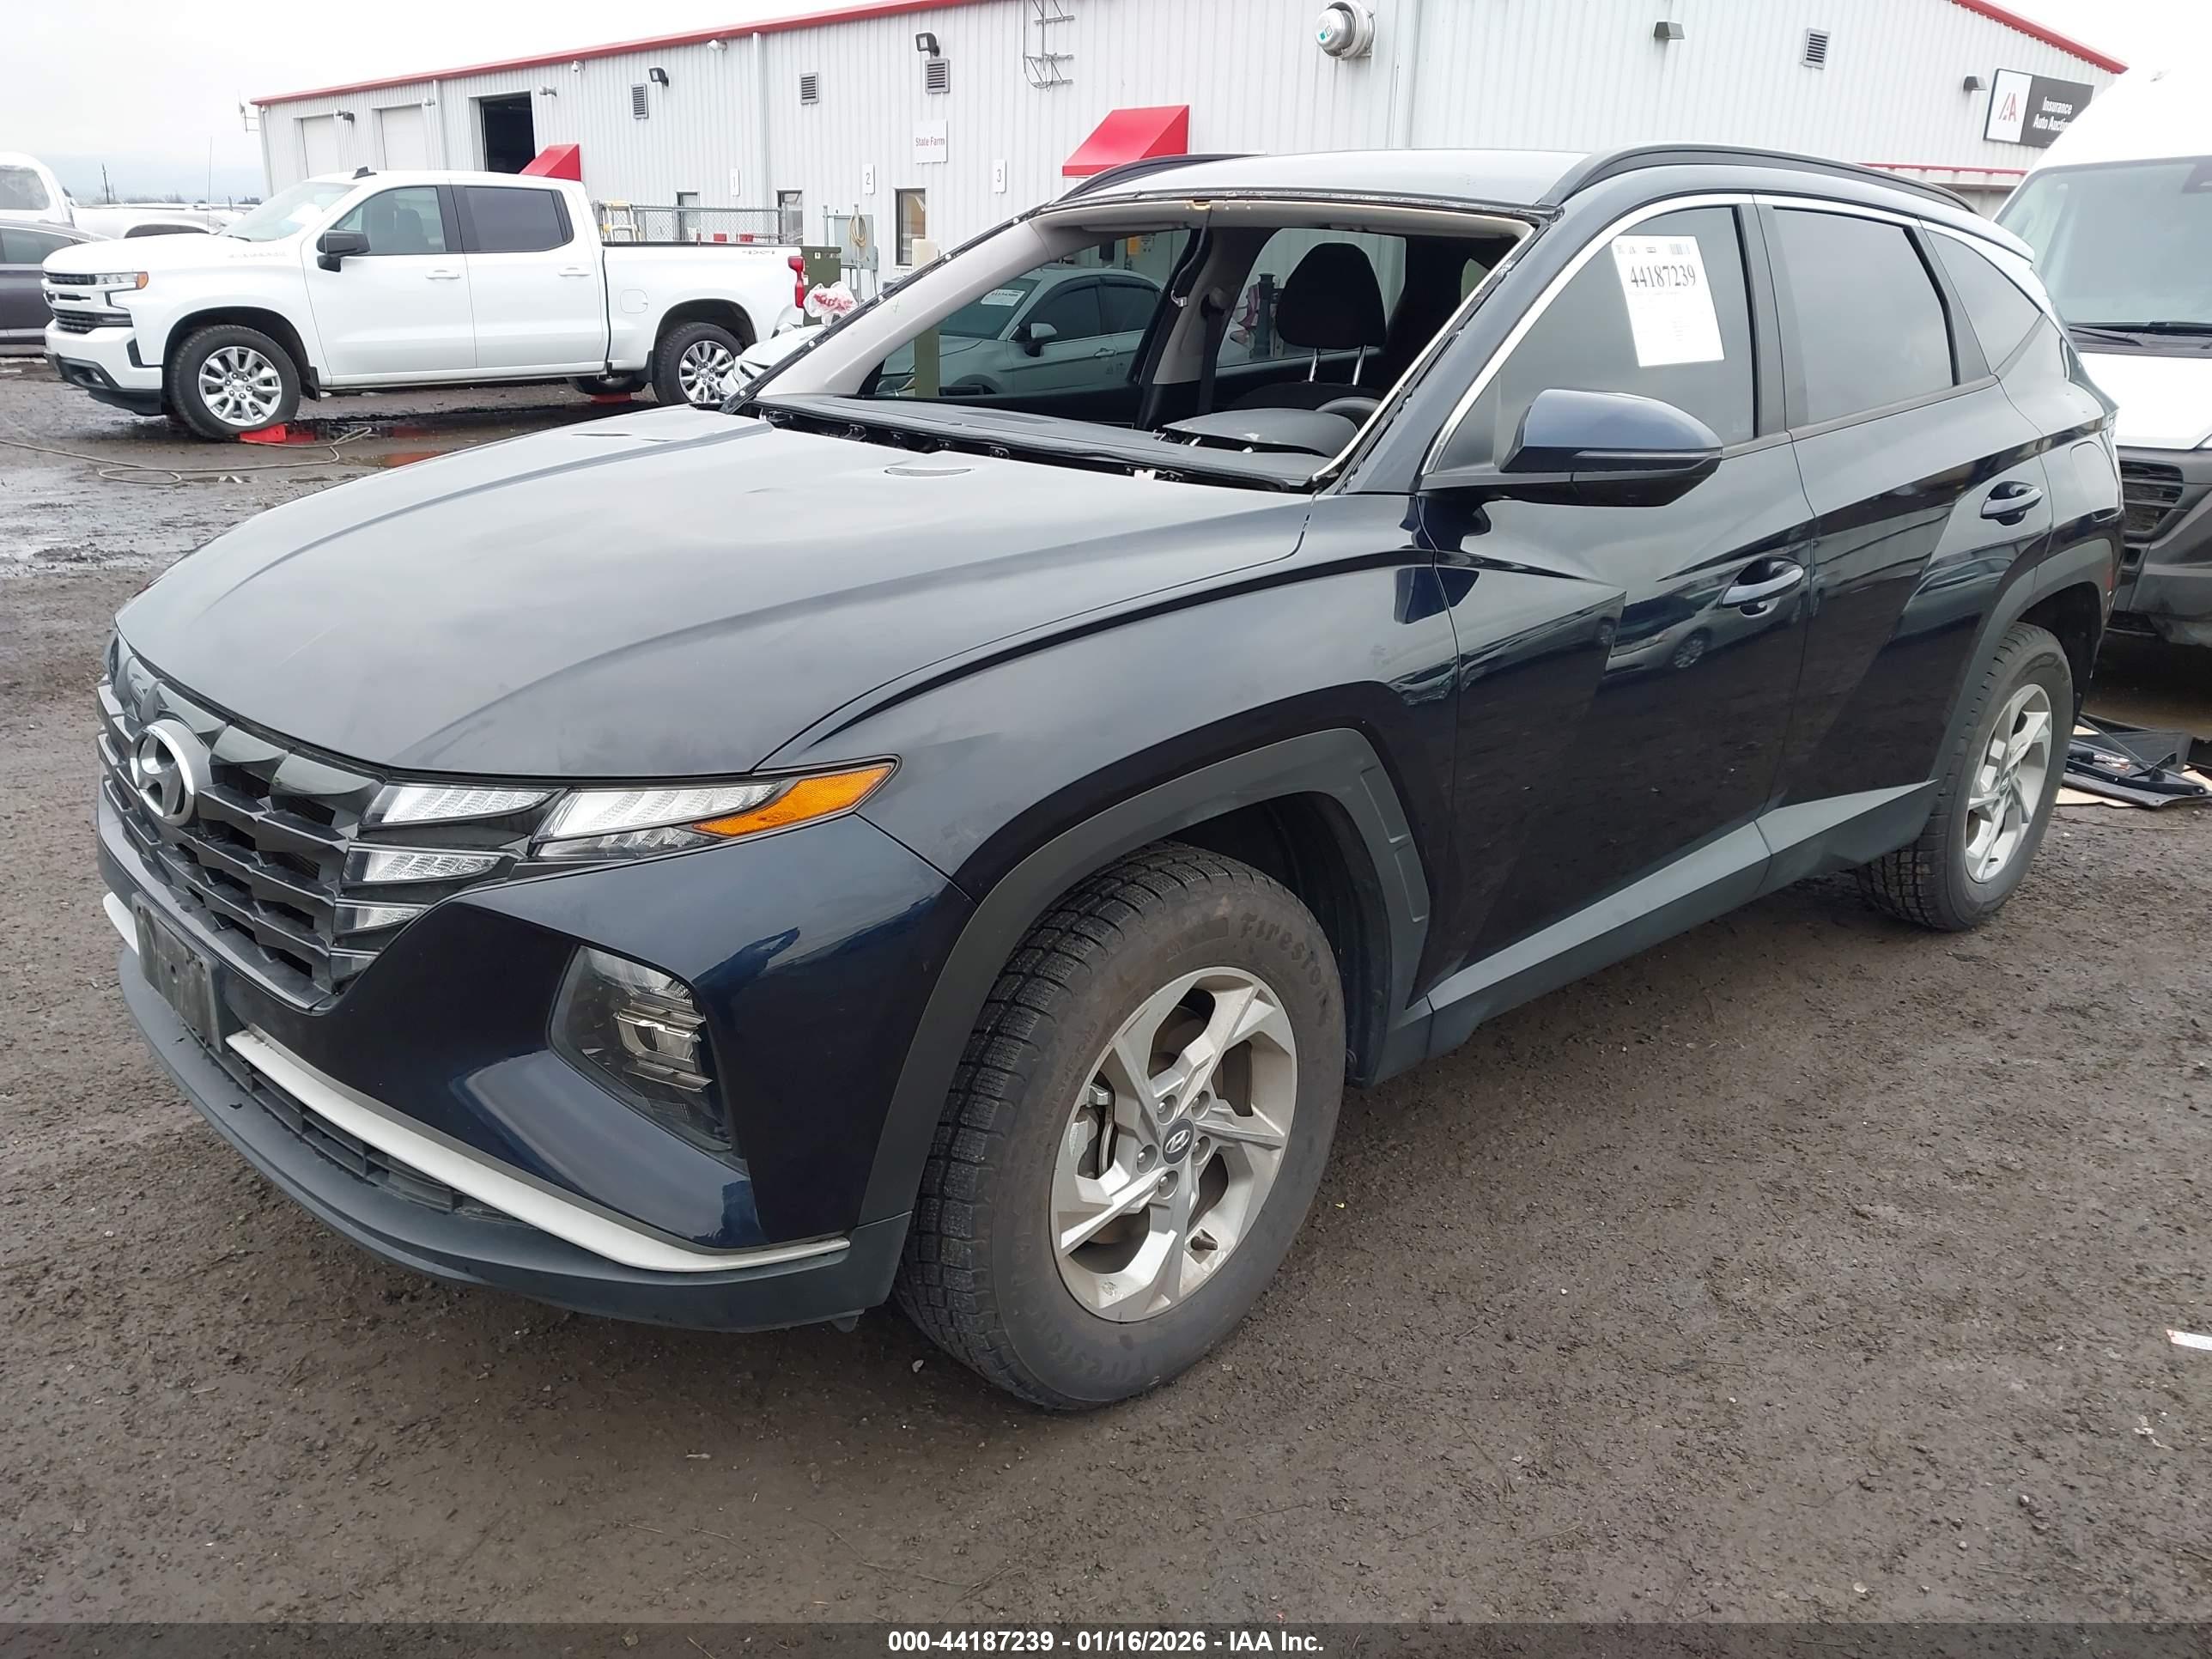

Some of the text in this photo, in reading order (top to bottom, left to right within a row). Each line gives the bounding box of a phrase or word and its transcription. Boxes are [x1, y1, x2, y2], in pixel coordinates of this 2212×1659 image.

[2043, 95, 2073, 115] Insurance
[2033, 113, 2049, 129] Auto
[915, 136, 945, 147] State Farm
[866, 173, 871, 185] 2
[997, 168, 1001, 183] 3
[1631, 264, 1696, 288] 44187239
